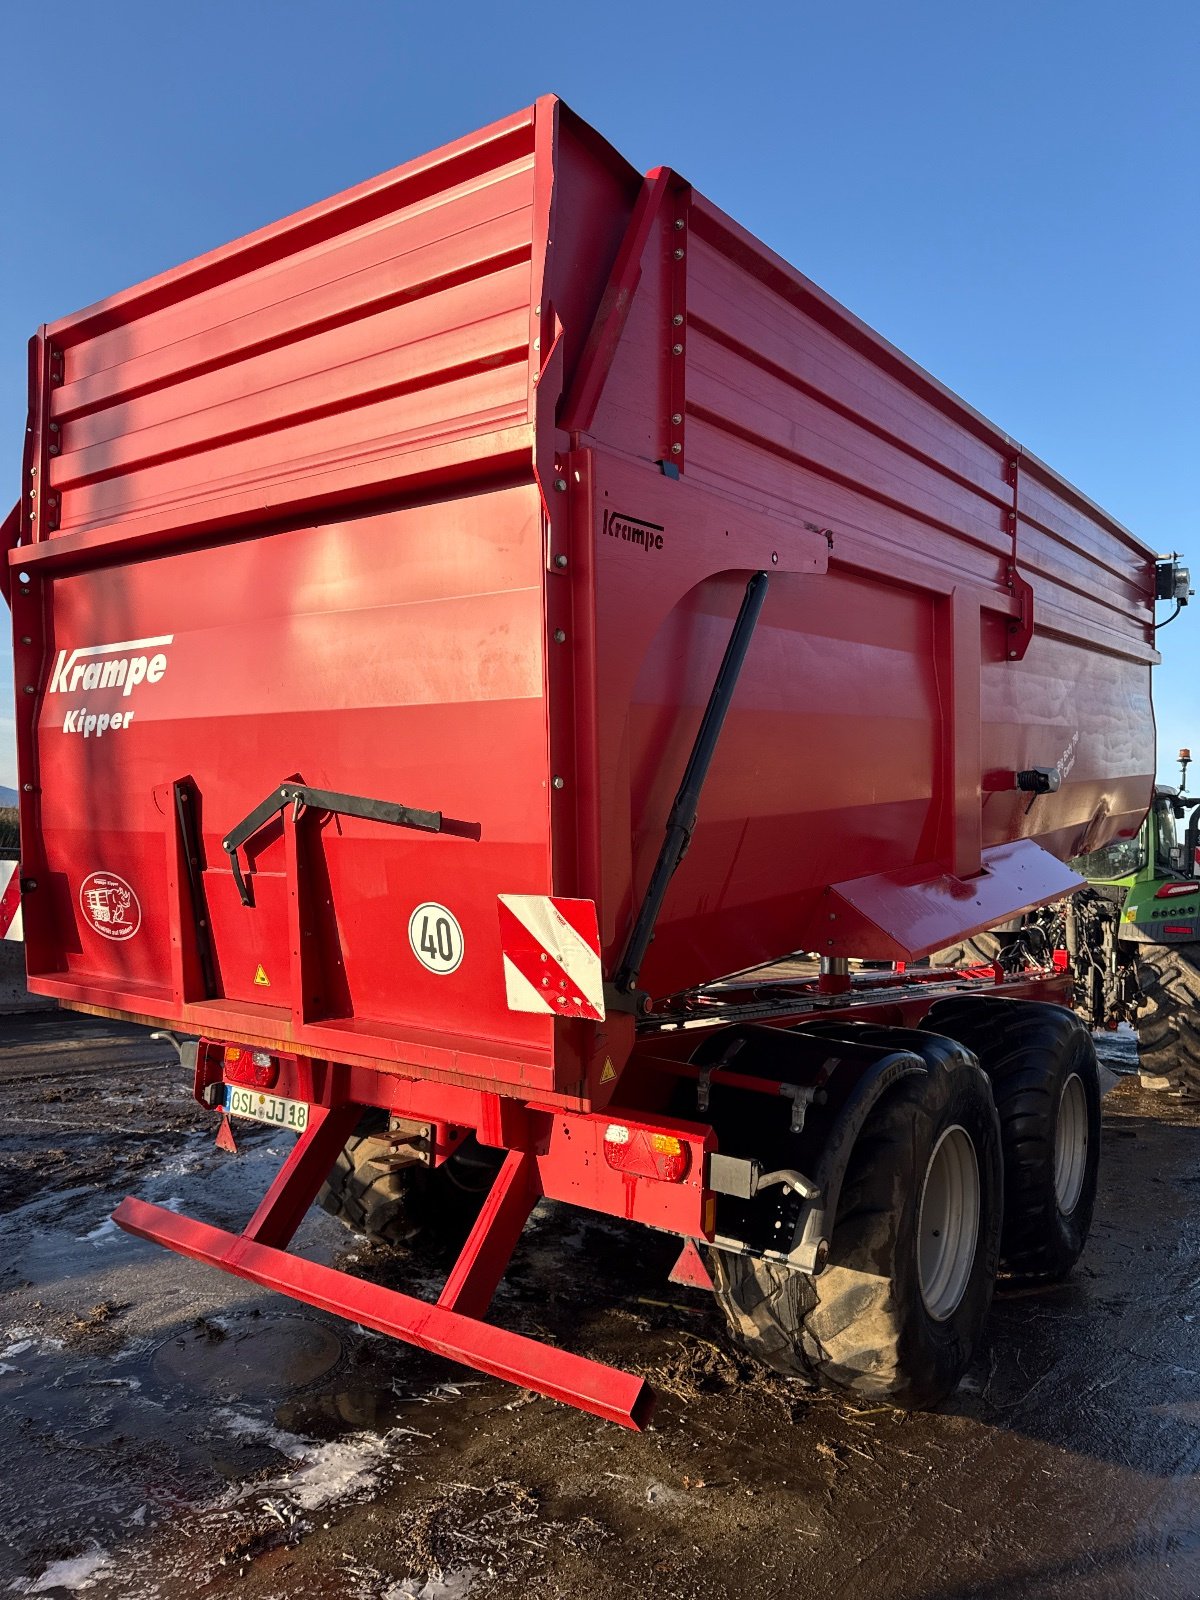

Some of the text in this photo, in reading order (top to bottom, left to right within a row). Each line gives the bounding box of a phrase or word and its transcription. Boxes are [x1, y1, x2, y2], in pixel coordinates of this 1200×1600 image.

[603, 509, 664, 552] Krampe
[49, 634, 174, 696] Krampe
[63, 708, 134, 738] Kipper
[421, 915, 454, 961] 40
[232, 1091, 306, 1128] OSL JJ 18
